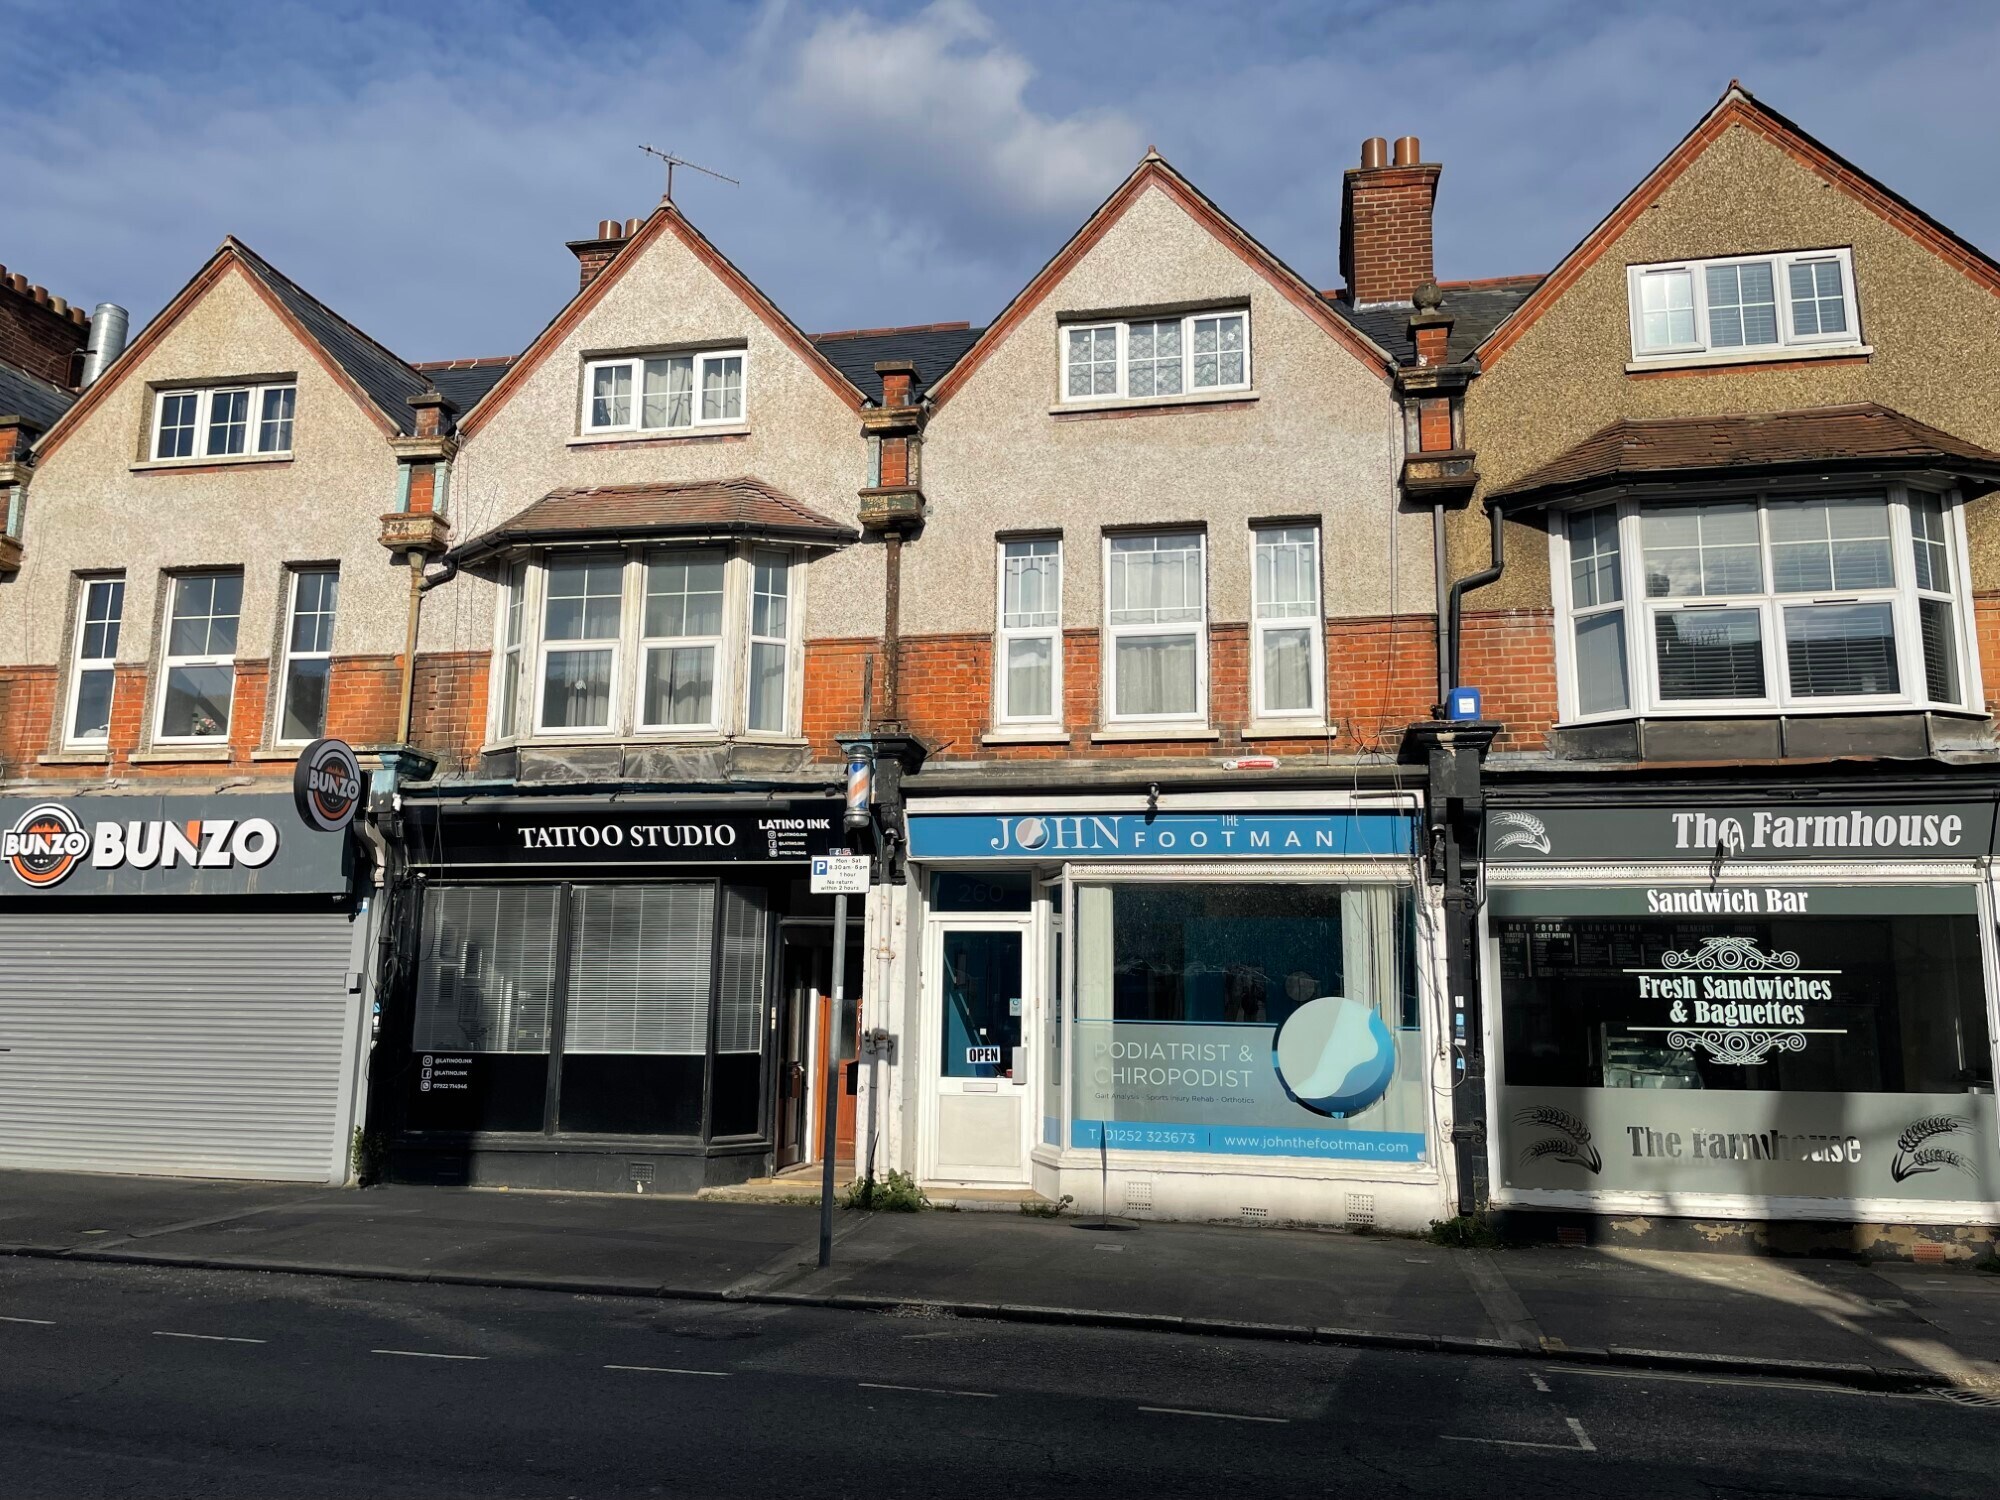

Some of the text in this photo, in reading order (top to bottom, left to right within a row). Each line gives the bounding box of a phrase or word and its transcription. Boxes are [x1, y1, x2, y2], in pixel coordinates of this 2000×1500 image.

[308, 768, 360, 802] BUNZO
[758, 818, 831, 830] LATINO INK
[1222, 815, 1239, 827] THE
[1672, 810, 1962, 848] The Farmhouse
[92, 817, 278, 869] BUNZO
[518, 824, 737, 849] TATTOO STUDIO
[990, 816, 1124, 851] JOHN
[1134, 830, 1334, 848] FOOTMAN
[5, 832, 86, 857] BUNZO
[958, 884, 1004, 902] 260
[1647, 888, 1809, 913] Sandwich Bar
[1535, 923, 1561, 931] FOOD
[1638, 976, 1697, 999] Fresh
[1703, 976, 1832, 1000] Sandwiches
[1669, 1000, 1805, 1027] & Baguettes
[969, 1048, 998, 1063] OPEN
[1095, 1042, 1253, 1062] PODIATRIST &
[1095, 1067, 1253, 1088] CHIROPODIST
[1111, 1093, 1140, 1101] Analysis
[1222, 1096, 1254, 1104] Orthotics
[1089, 1129, 1195, 1144] T. 01252 323673
[1224, 1136, 1409, 1153] www.johnthefootman.com
[1627, 1126, 1682, 1158] The
